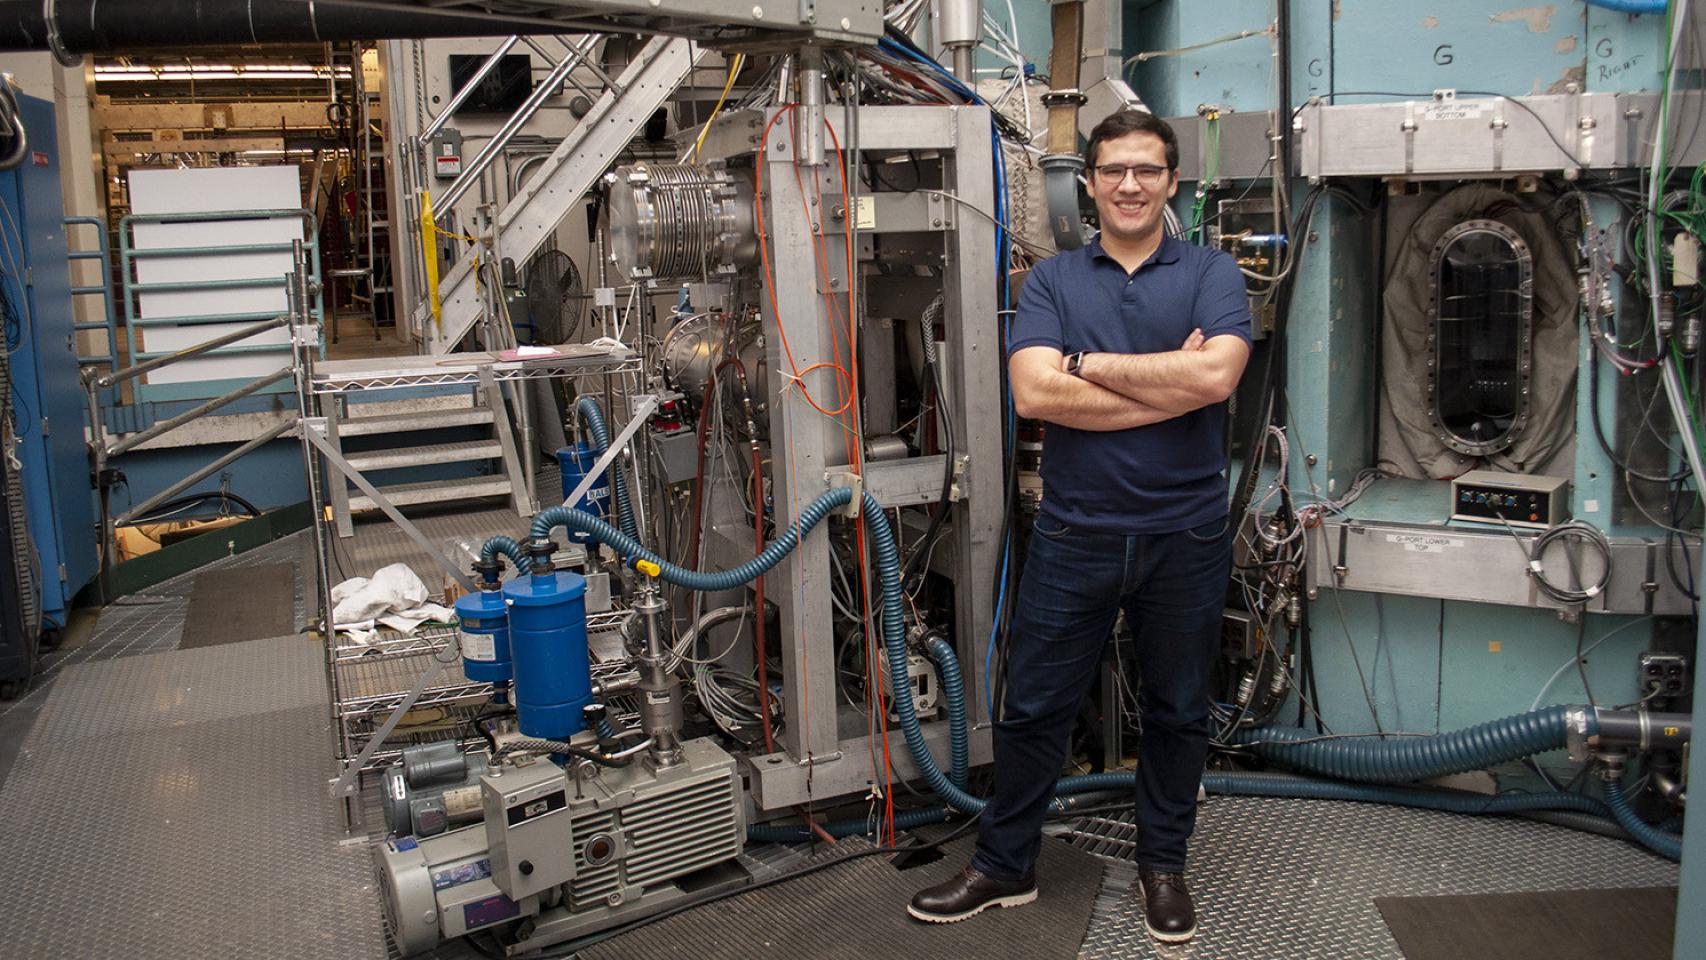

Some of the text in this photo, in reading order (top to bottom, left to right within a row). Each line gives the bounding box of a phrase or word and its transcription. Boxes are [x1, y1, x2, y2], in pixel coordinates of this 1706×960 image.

[1433, 44, 1453, 66] G
[1595, 37, 1612, 58] G
[1308, 58, 1323, 77] G
[1599, 54, 1644, 82] RIGHT
[1435, 111, 1466, 120] BOTTOM
[1414, 543, 1429, 551] TOP
